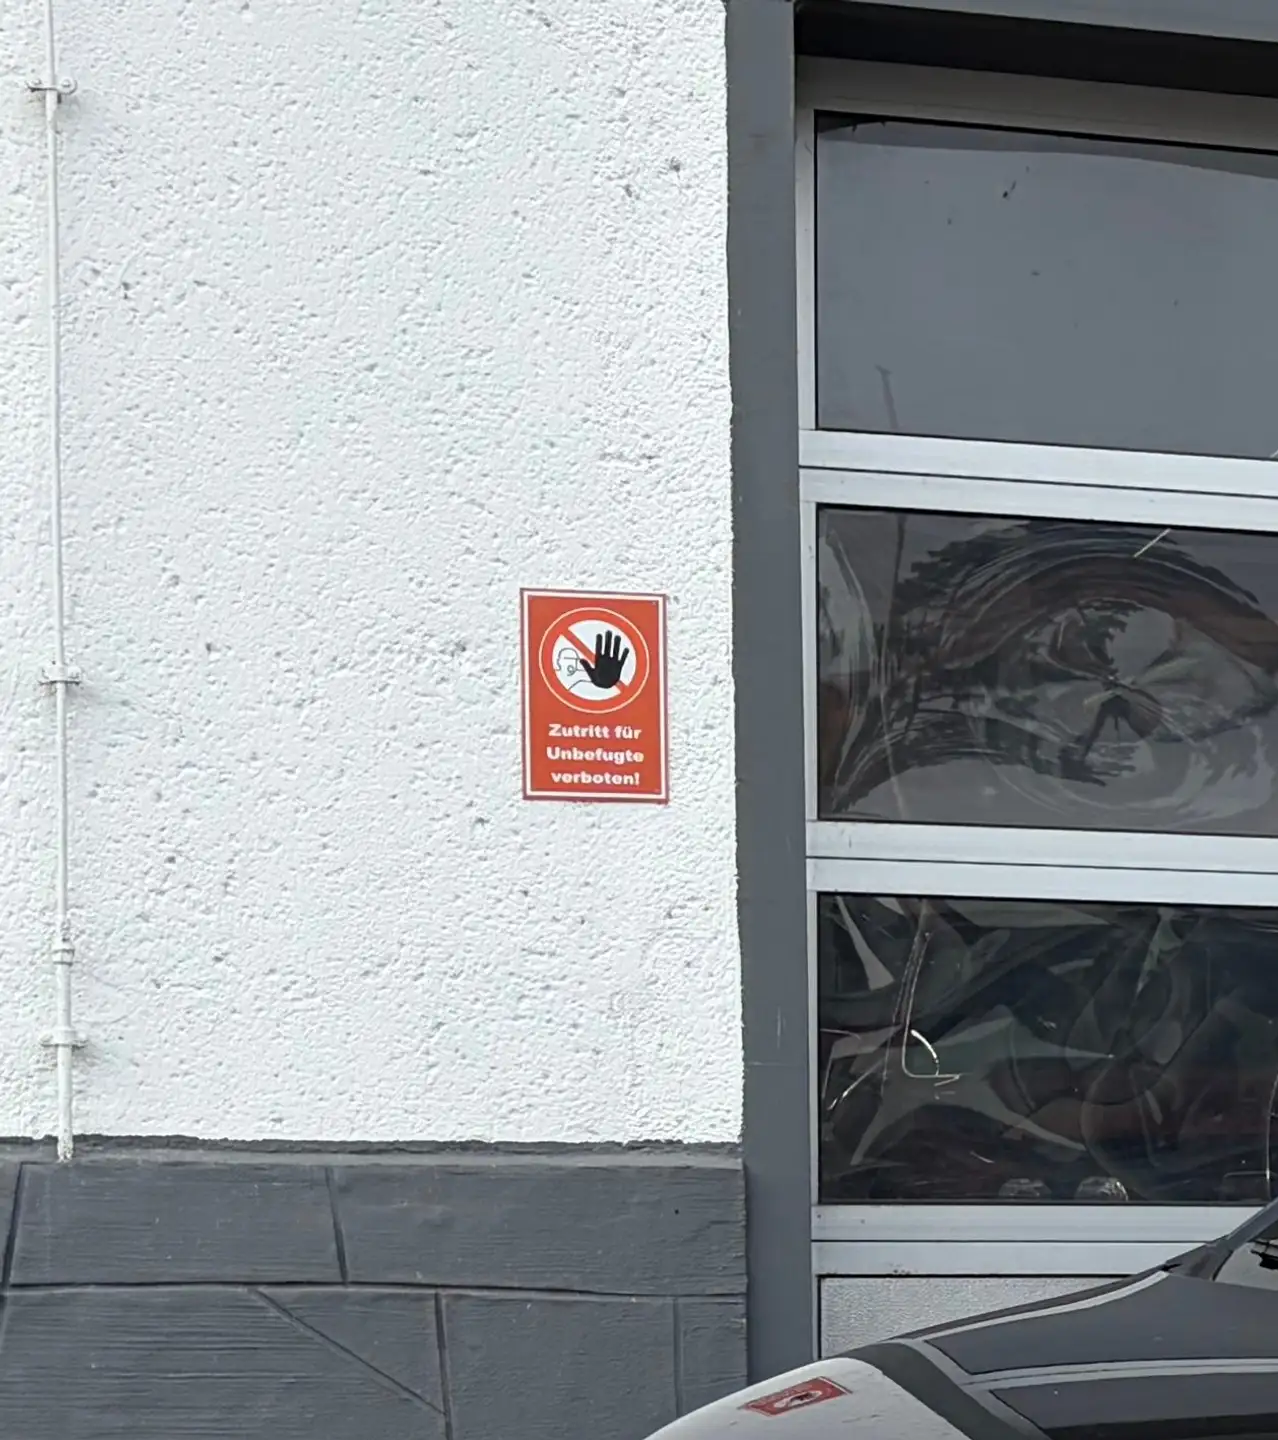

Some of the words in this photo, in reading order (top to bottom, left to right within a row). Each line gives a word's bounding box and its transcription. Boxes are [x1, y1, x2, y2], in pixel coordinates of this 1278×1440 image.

[548, 723, 610, 739] Zutritt
[614, 725, 642, 740] für
[545, 746, 645, 764] Unbefugte
[550, 770, 641, 785] verboten!
